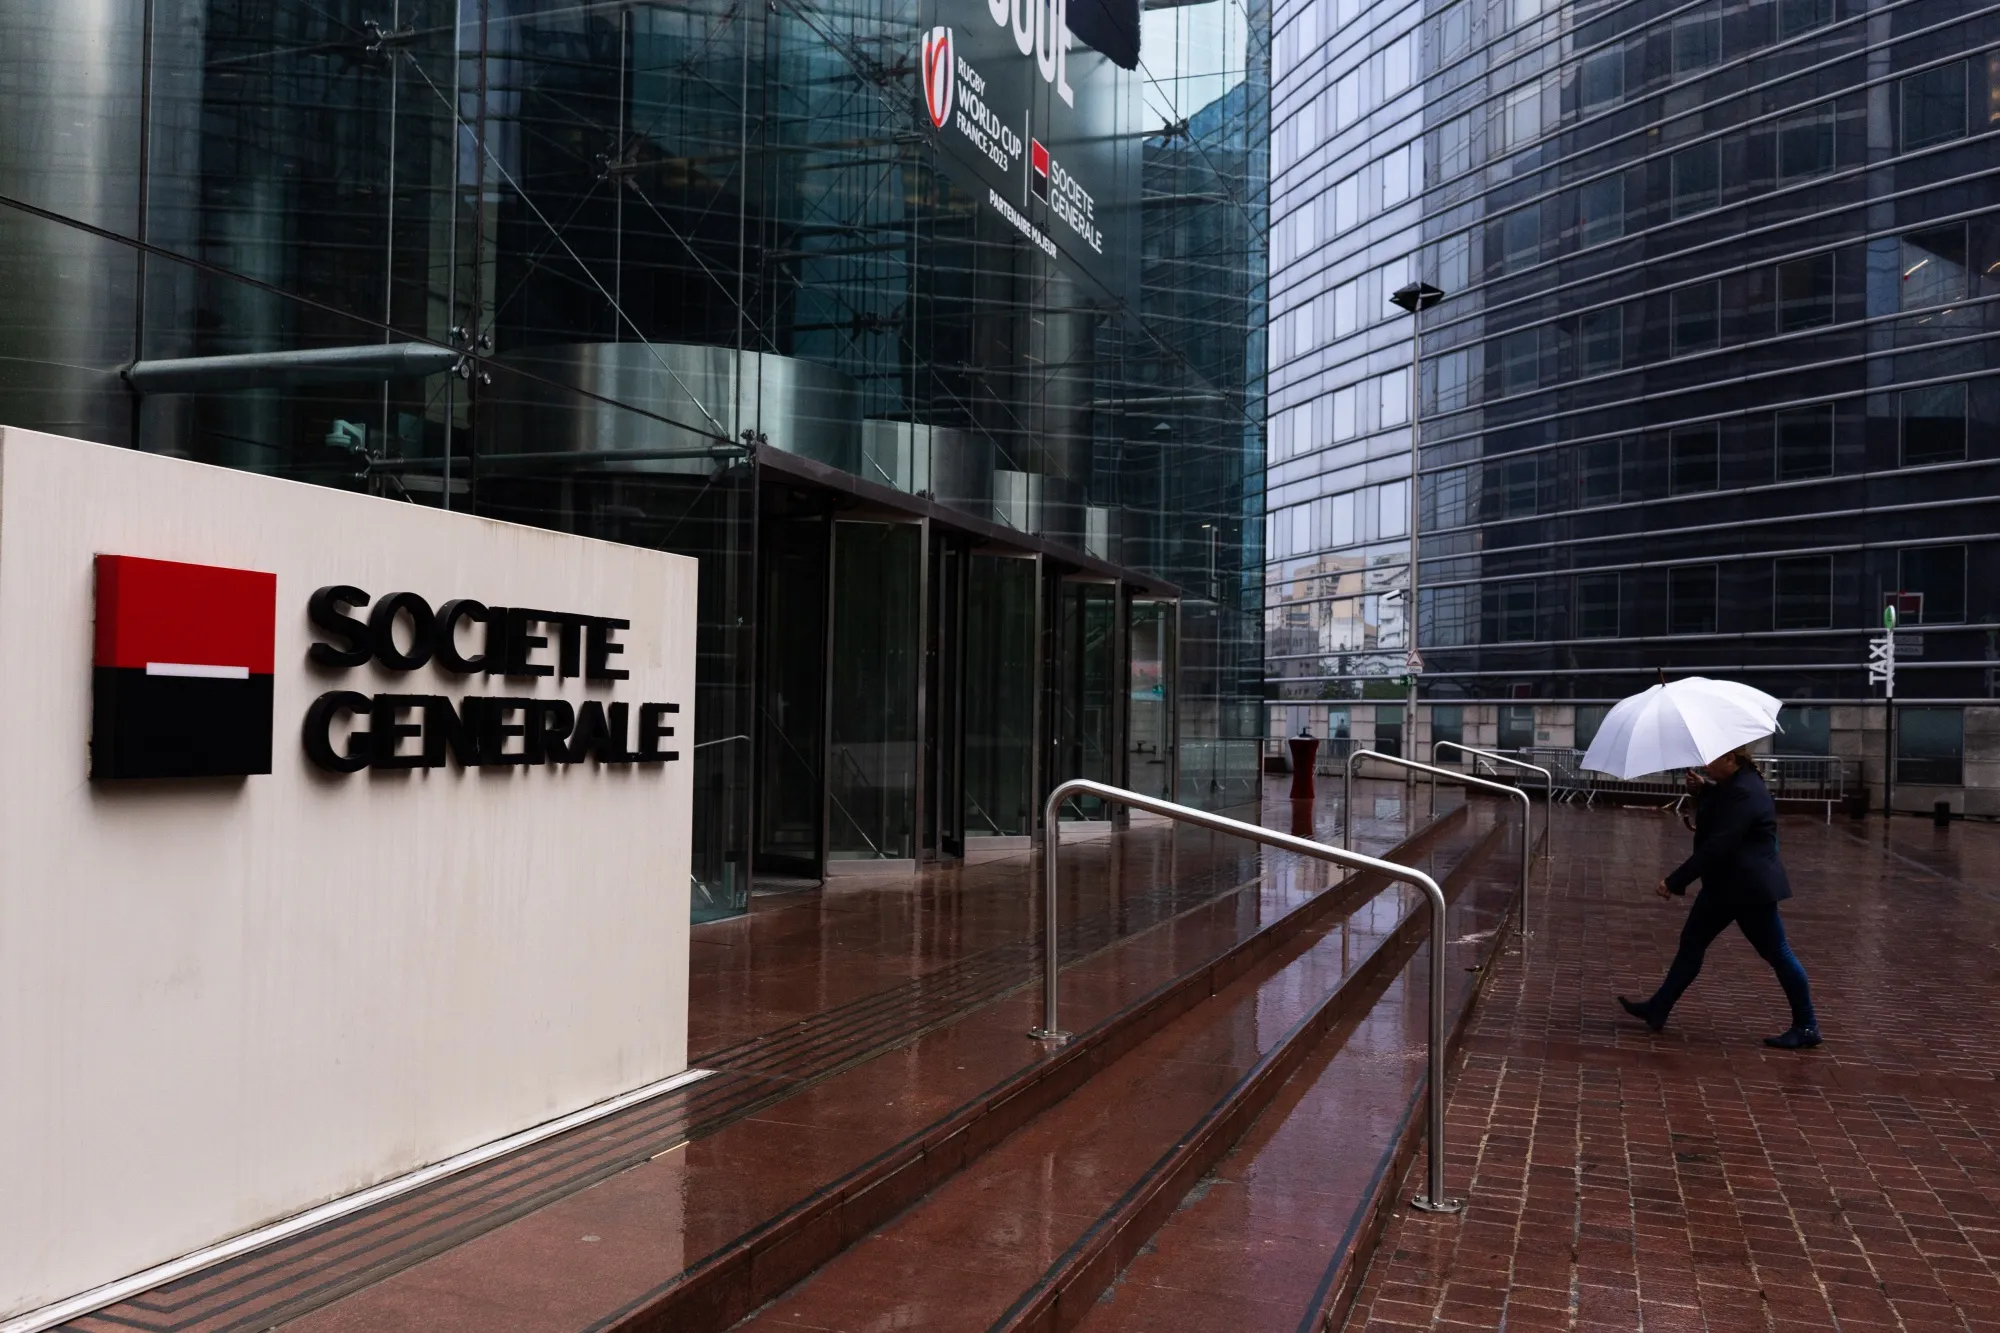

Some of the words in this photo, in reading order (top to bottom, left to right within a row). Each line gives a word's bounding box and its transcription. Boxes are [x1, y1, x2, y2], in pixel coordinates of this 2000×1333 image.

[958, 56, 985, 97] RUGBY
[957, 110, 988, 154] FRANCE
[989, 141, 1008, 172] 2023
[958, 80, 1000, 140] WORLD
[1001, 125, 1022, 160] CUP
[989, 188, 1031, 238] PARTENAIRE
[1031, 225, 1057, 260] MAJEUR
[1051, 160, 1094, 221] SOCIETE
[1051, 188, 1103, 255] GENERALE
[308, 584, 631, 681] SOCIETE
[1869, 638, 1888, 686] TAXI
[302, 690, 680, 773] GENERALE
